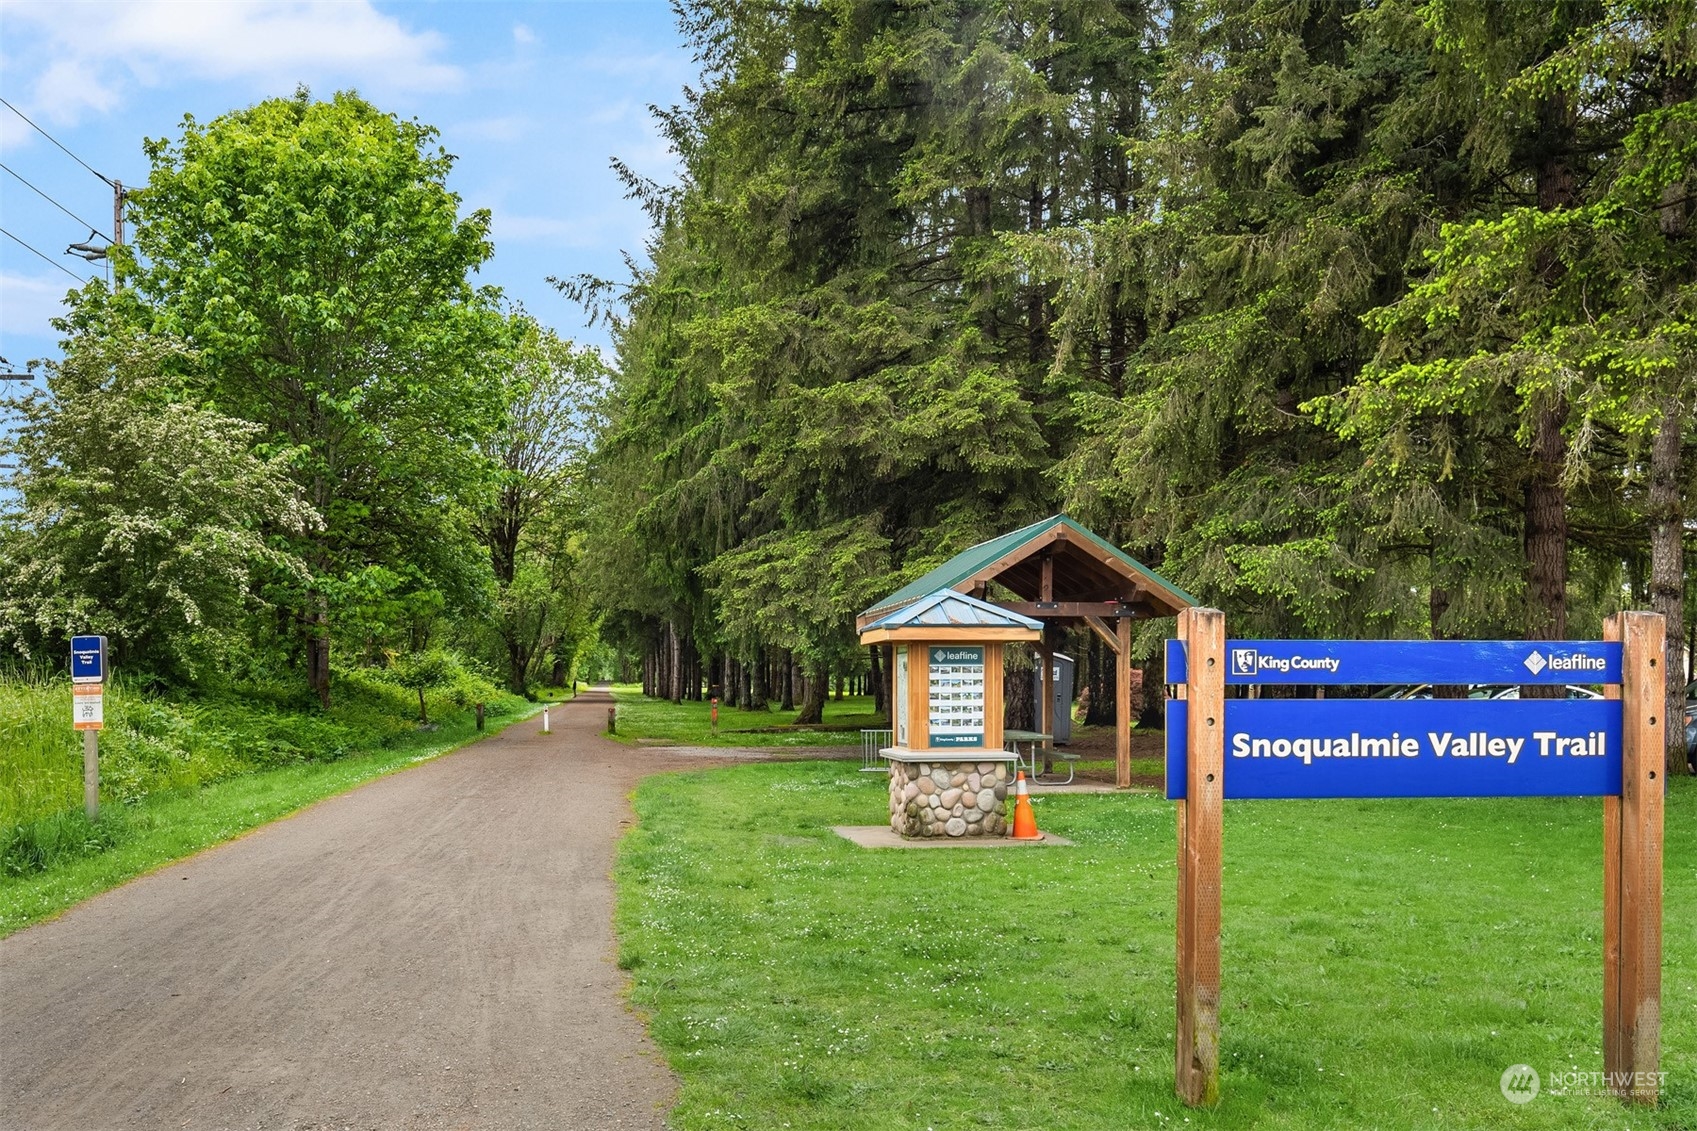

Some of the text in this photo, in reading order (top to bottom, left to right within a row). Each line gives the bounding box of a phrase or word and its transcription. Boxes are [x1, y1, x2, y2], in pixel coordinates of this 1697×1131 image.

[946, 651, 979, 660] leafline
[1258, 655, 1340, 672] King County
[1548, 653, 1606, 670] leafline
[1232, 731, 1606, 764] Snoqualmie Valley Trail
